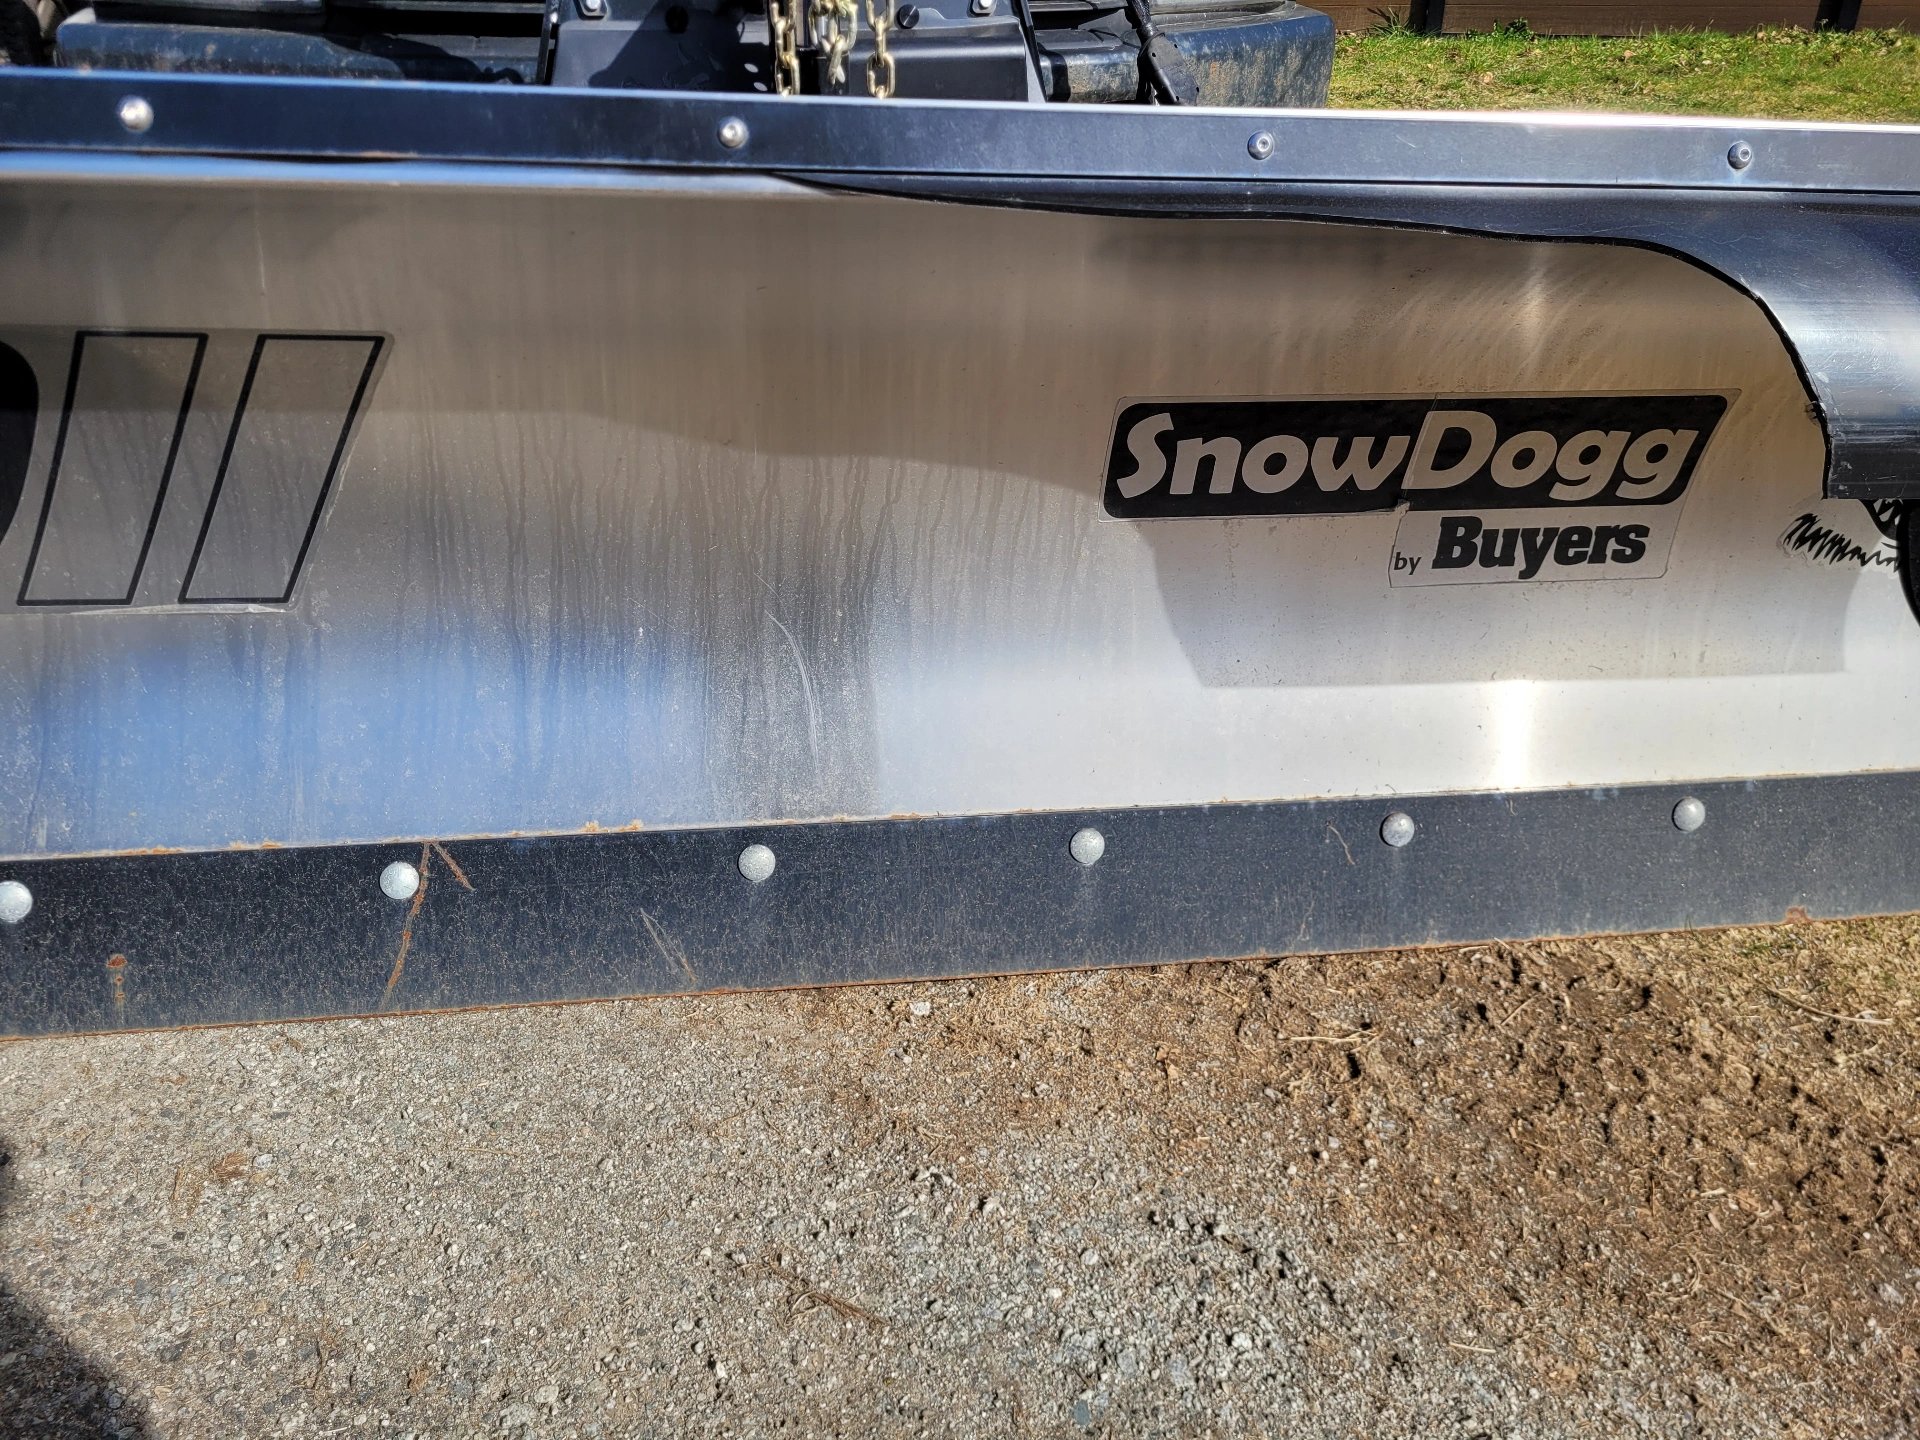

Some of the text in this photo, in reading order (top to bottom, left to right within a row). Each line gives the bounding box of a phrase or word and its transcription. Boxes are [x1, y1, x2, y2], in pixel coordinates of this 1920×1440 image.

[1116, 410, 1699, 501] SnowDogg
[1393, 516, 1650, 579] by Buyers
